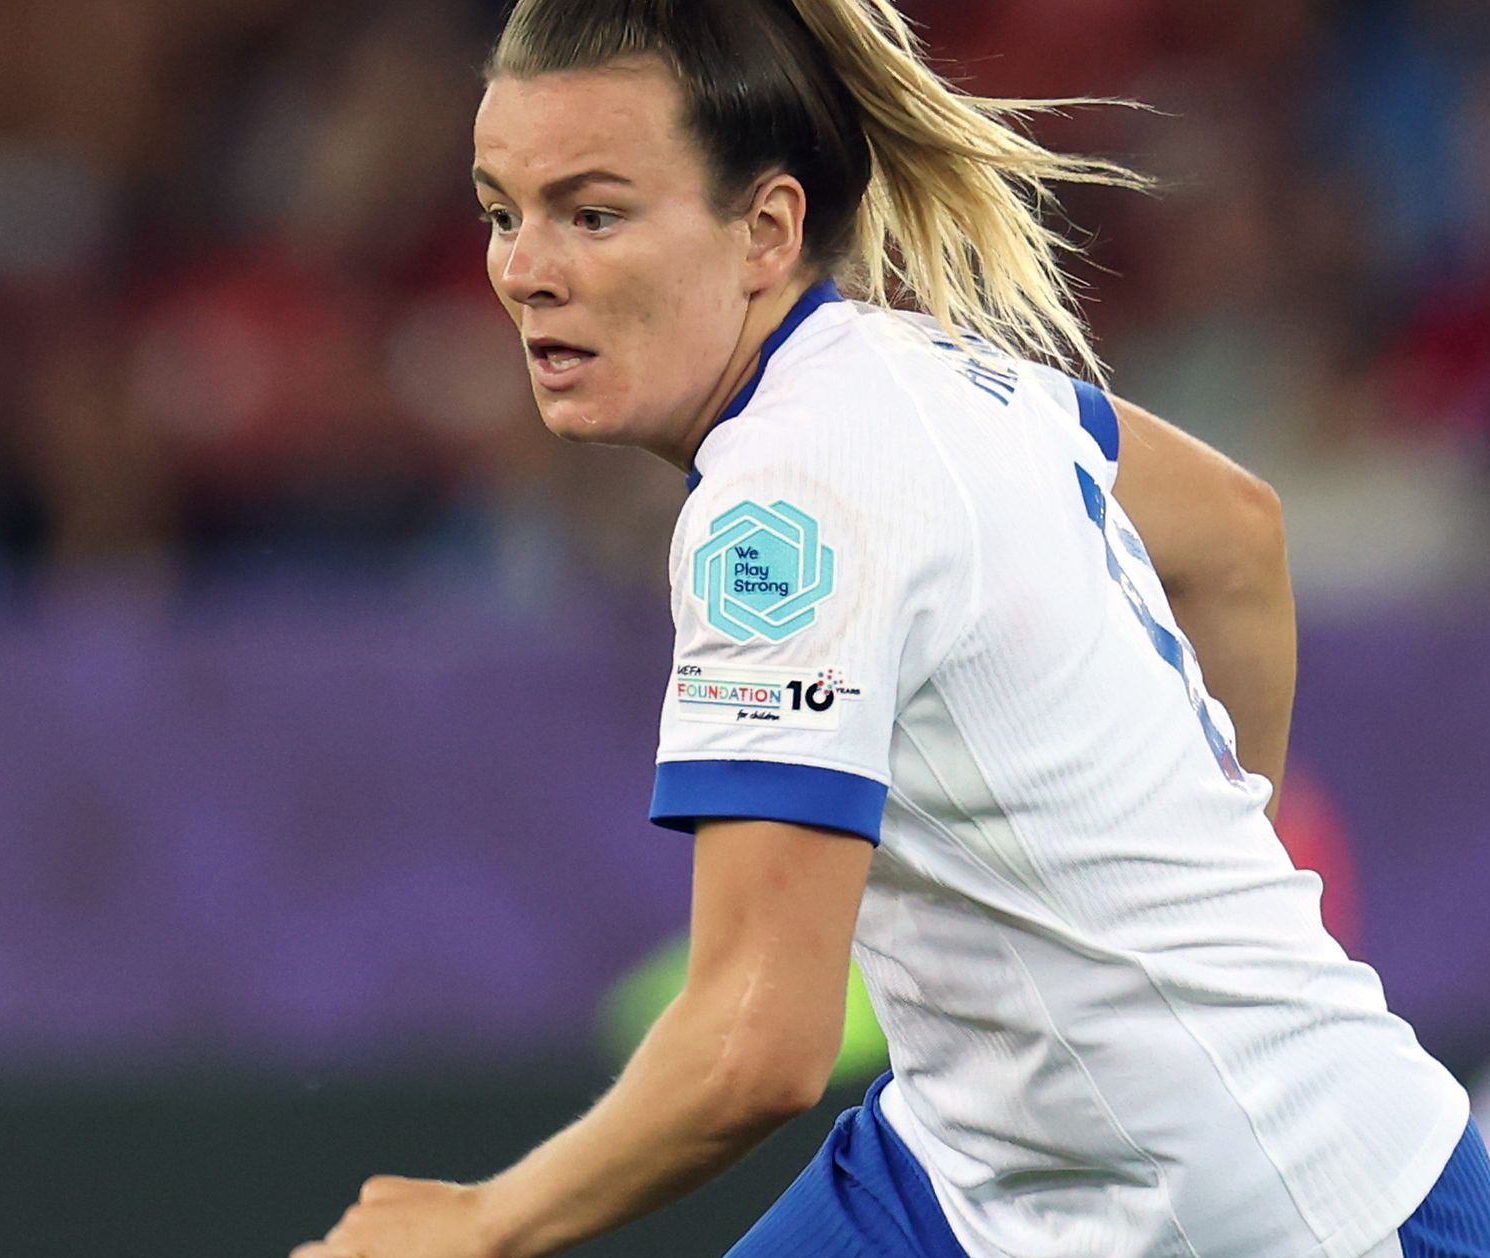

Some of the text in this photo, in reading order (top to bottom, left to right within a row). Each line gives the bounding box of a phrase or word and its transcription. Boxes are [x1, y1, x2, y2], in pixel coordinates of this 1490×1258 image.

[734, 545, 759, 560] We
[734, 562, 769, 581] Play
[734, 579, 789, 597] Strong
[677, 665, 702, 677] UEFA
[786, 680, 835, 712] 10
